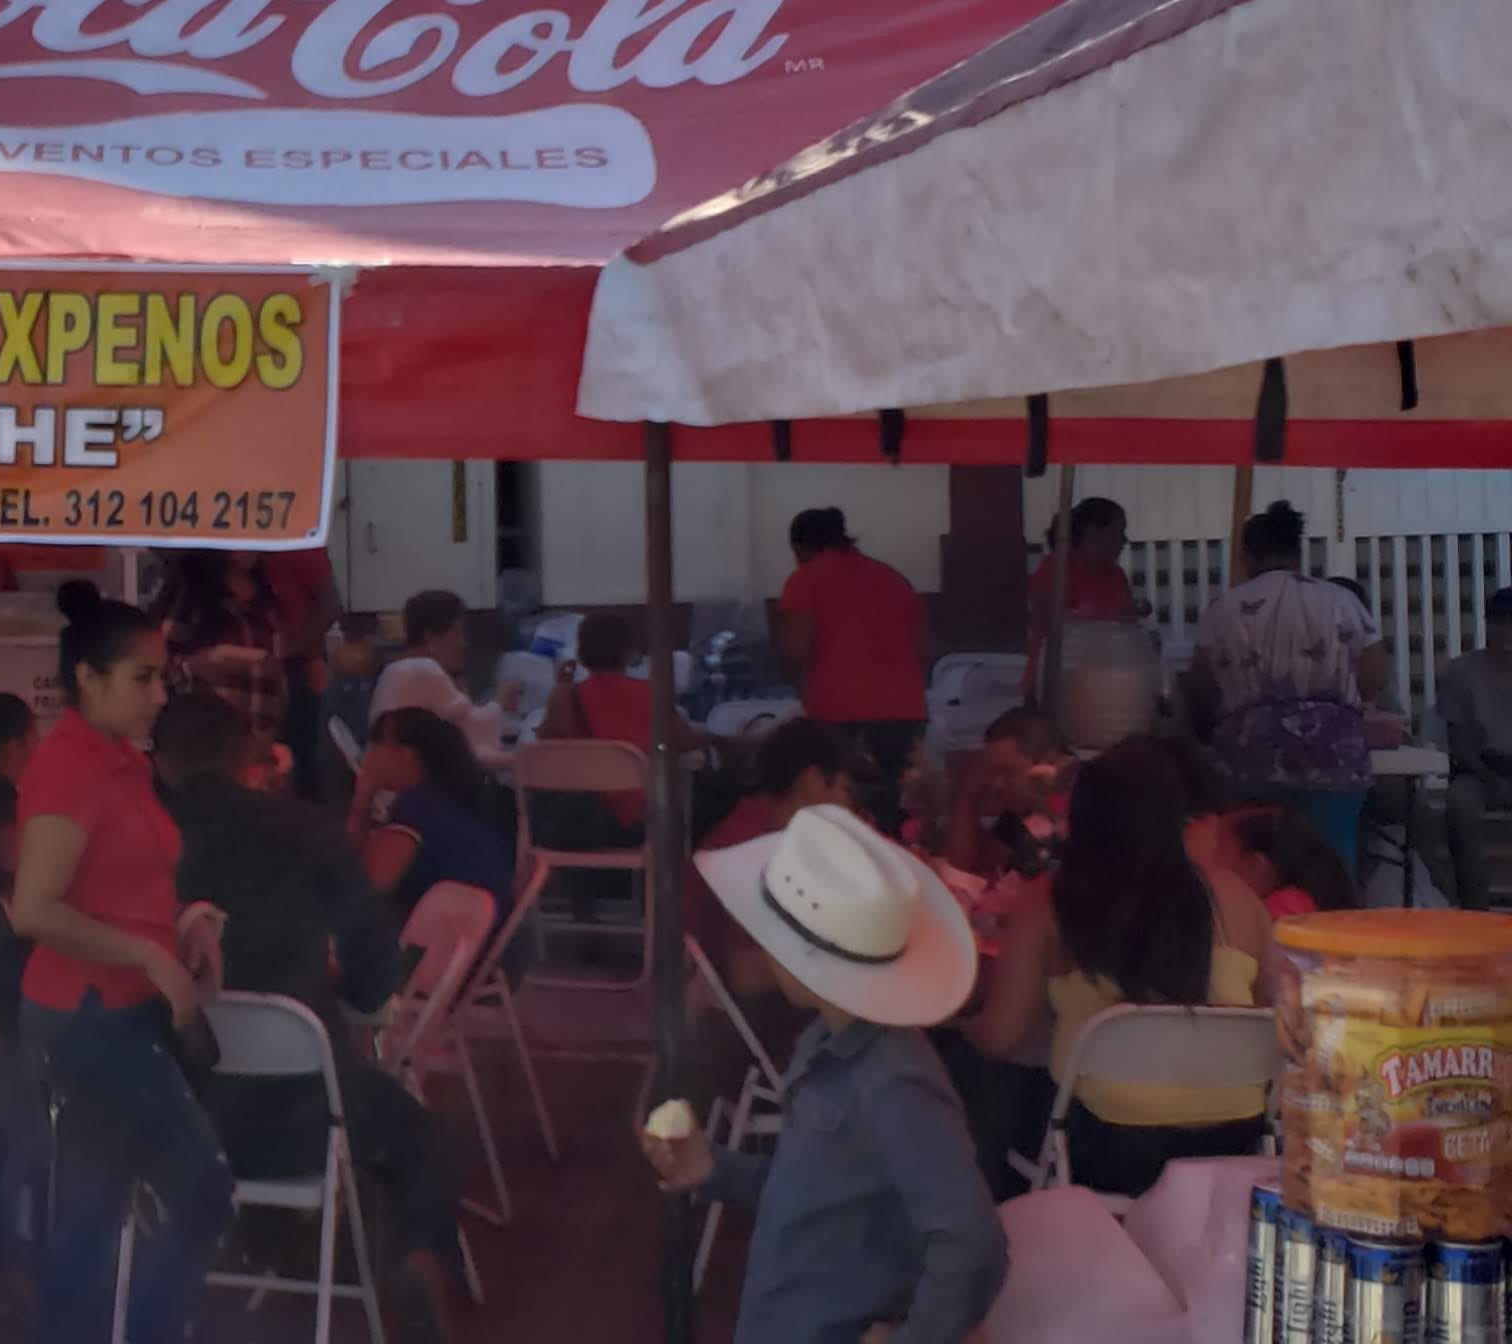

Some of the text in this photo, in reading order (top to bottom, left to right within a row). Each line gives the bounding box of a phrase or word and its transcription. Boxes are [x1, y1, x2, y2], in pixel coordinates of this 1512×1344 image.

[244, 146, 610, 172] ESPECIALES
[63, 489, 126, 528] 312
[140, 491, 199, 530] 104
[212, 491, 297, 530] 2157
